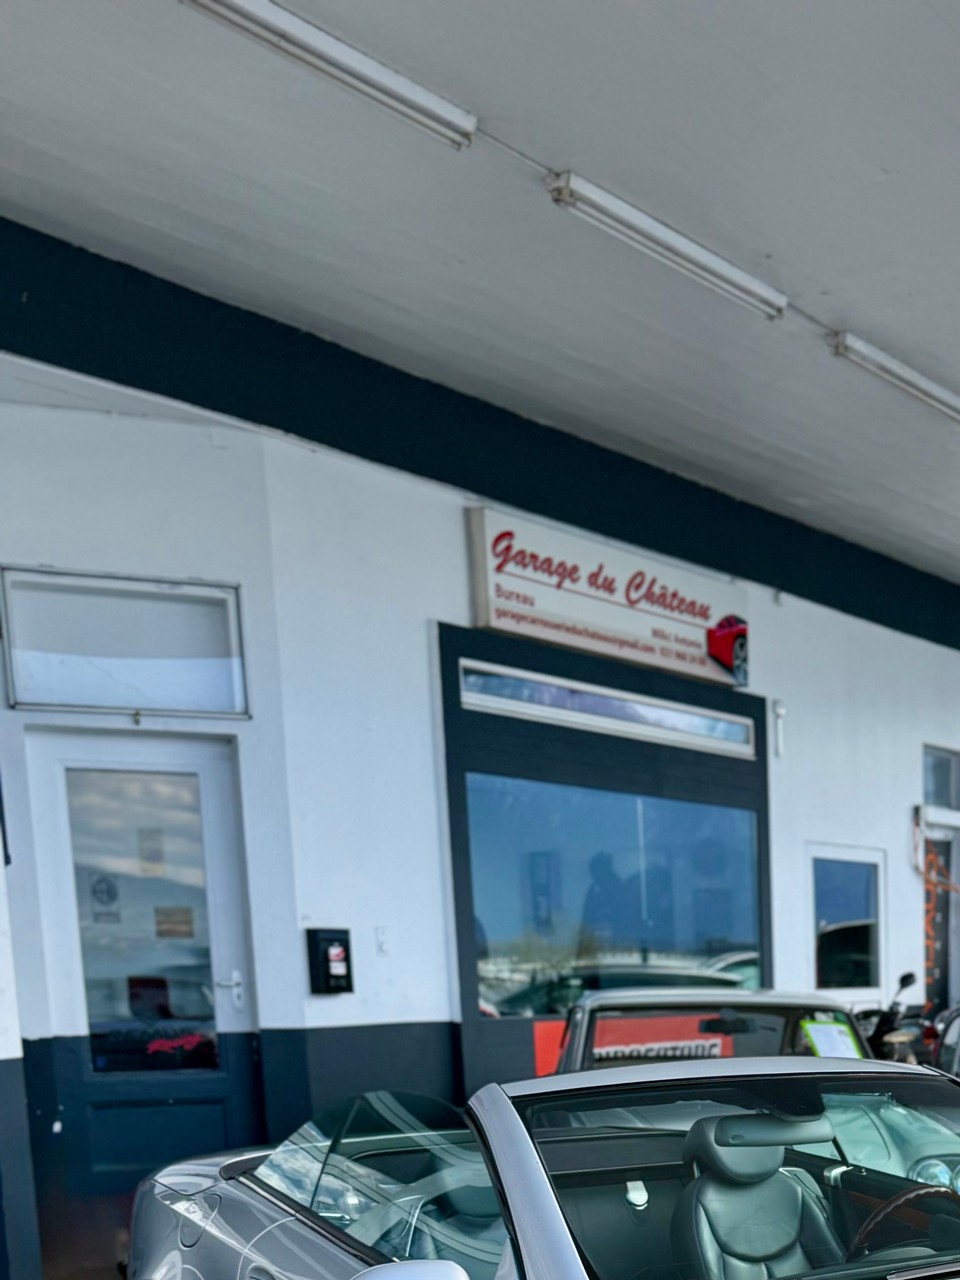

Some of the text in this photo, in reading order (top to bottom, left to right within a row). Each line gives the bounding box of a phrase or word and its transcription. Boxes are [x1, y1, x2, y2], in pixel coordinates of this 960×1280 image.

[491, 530, 710, 620] Garage du Château
[495, 583, 535, 607] Bureau
